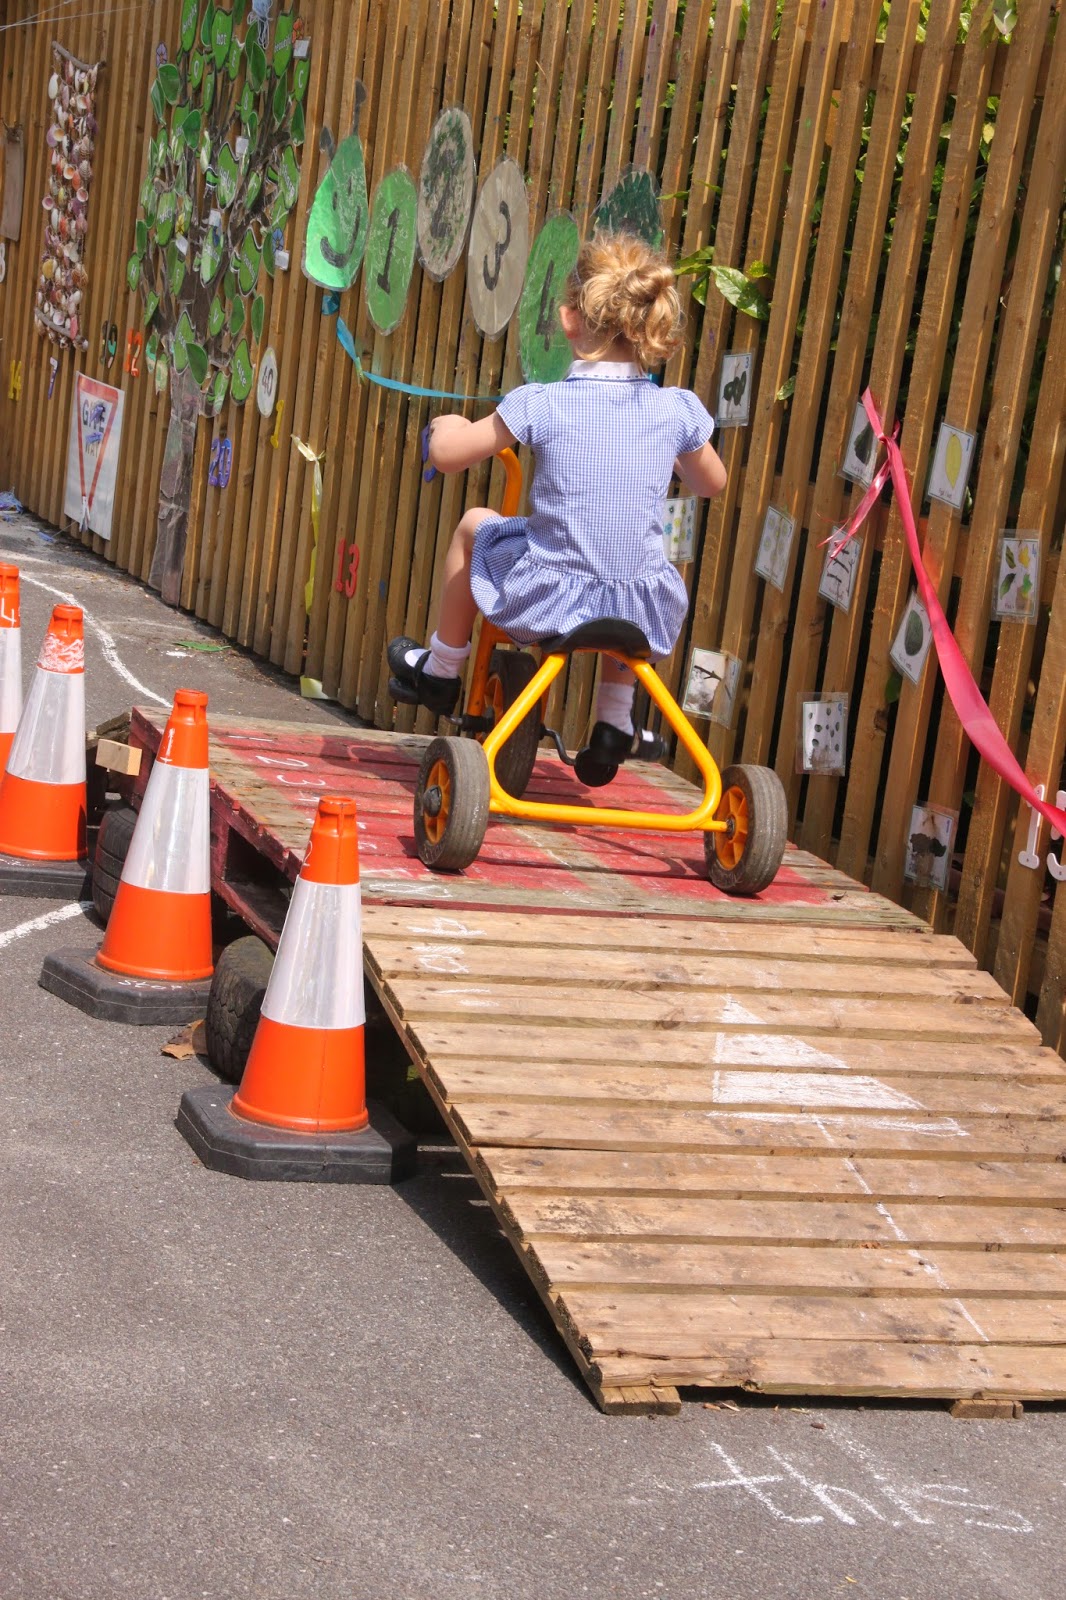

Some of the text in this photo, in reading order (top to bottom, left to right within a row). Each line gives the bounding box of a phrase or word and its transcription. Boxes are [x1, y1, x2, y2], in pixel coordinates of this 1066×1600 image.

[377, 207, 399, 295] 1
[483, 200, 512, 291] 3
[535, 259, 555, 352] 4
[124, 328, 143, 378] 12
[208, 437, 233, 489] 20
[335, 537, 360, 599] 13
